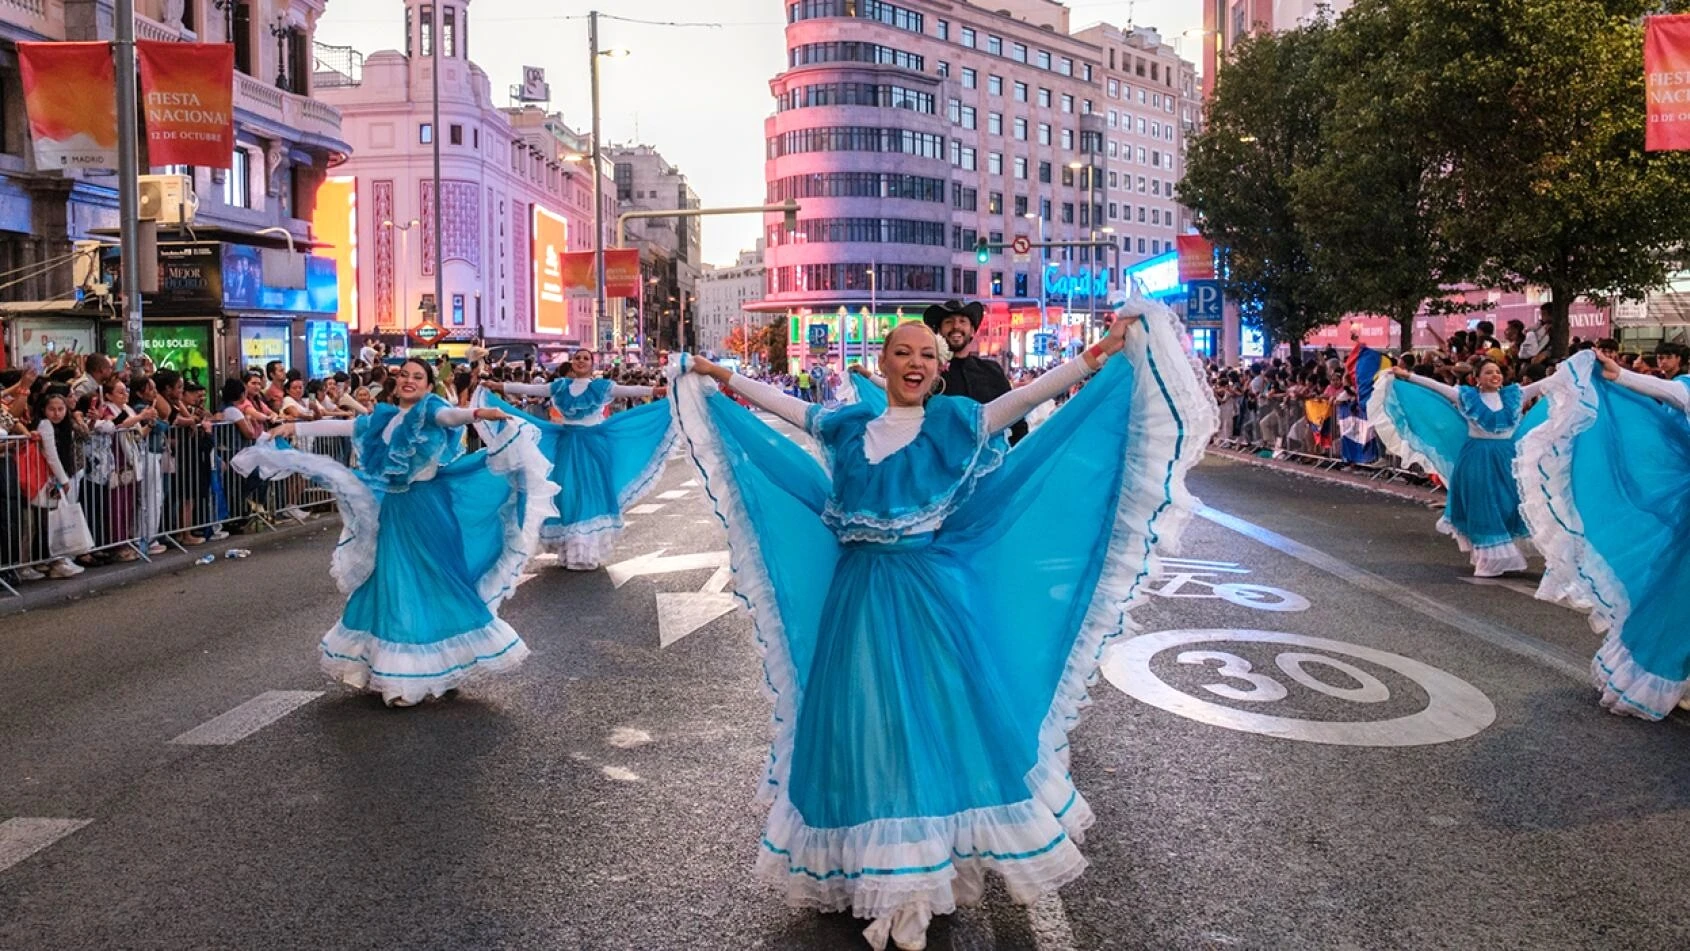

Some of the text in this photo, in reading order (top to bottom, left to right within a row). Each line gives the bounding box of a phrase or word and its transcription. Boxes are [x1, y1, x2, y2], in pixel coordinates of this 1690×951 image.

[148, 92, 201, 106] FIESTA
[149, 109, 230, 126] NACIONAL
[1661, 113, 1674, 121] DE
[151, 131, 222, 142] 12 DE OCTUBRE
[71, 155, 105, 164] MADRID
[169, 267, 201, 279] MEJOR
[1045, 265, 1109, 298] Capitol
[1197, 285, 1217, 314] P
[152, 339, 165, 349] DU
[166, 338, 198, 348] SOLEIL
[1177, 650, 1390, 703] 30
